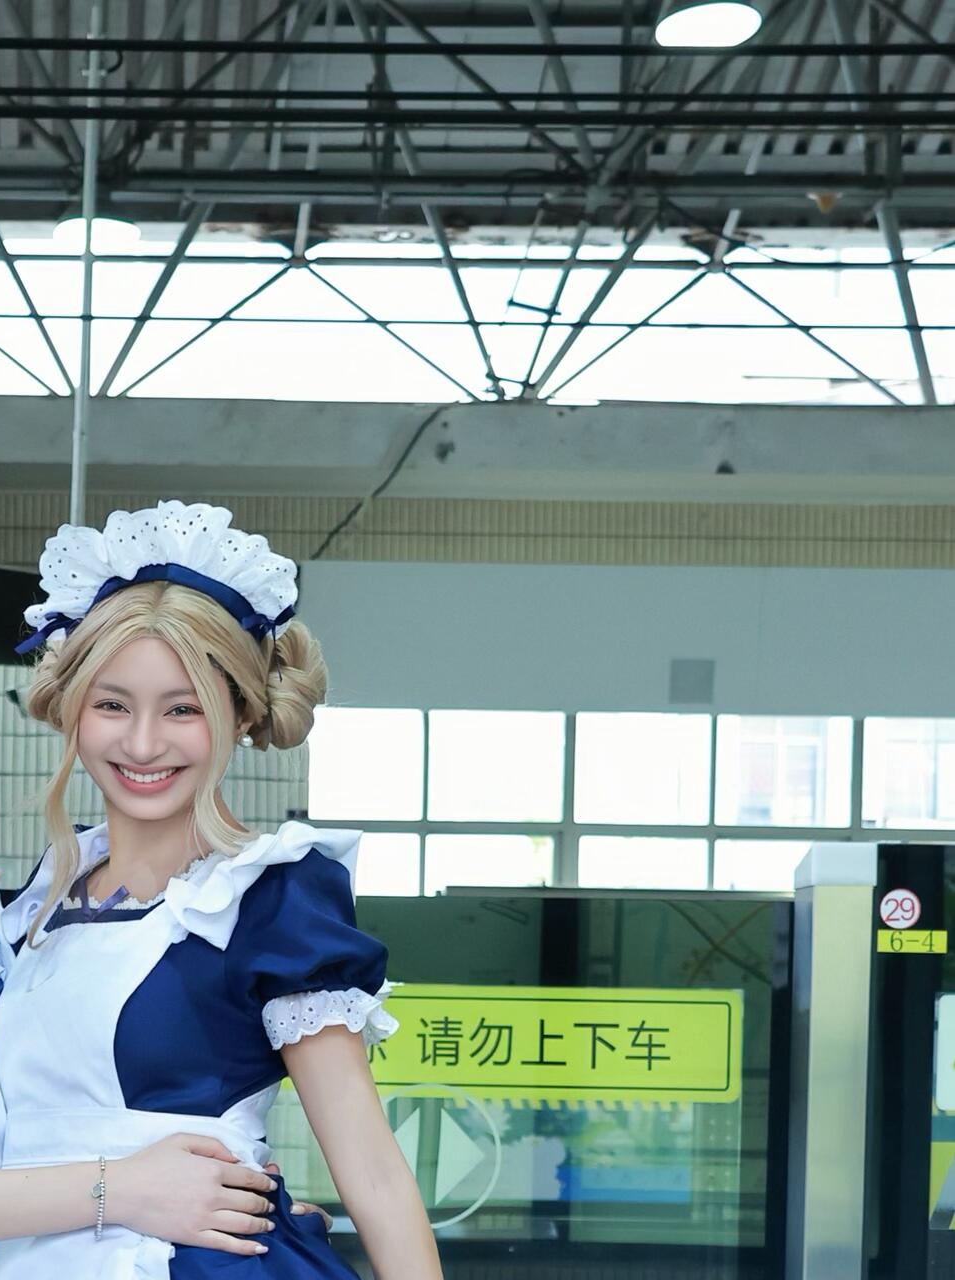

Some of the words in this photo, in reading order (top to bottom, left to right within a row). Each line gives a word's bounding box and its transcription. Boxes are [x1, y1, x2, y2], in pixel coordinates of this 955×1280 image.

[884, 897, 915, 922] 29
[890, 930, 935, 953] 6-4
[416, 1016, 671, 1071] 请勿上下车
